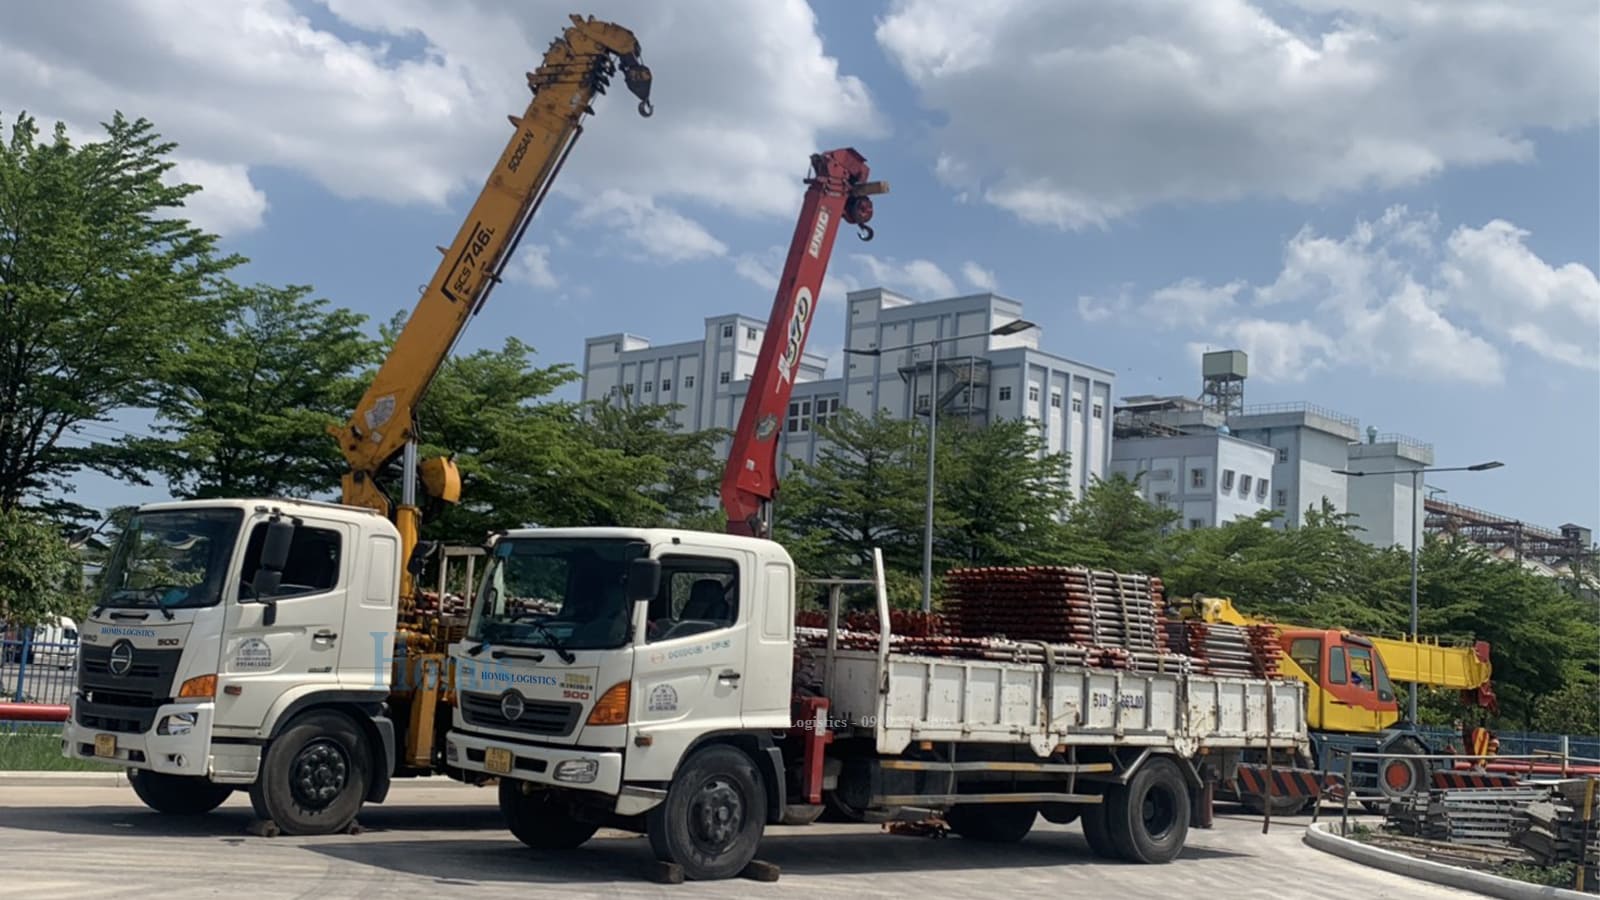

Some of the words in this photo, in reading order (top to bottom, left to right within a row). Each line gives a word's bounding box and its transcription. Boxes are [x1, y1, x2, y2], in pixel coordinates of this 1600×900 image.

[508, 128, 535, 174] SOOSAN
[100, 625, 122, 635] HOMIS
[123, 628, 156, 638] LOGISTICS
[157, 638, 180, 646] 500
[481, 671, 510, 682] HOMIS
[511, 674, 557, 686] LOGISTICS
[563, 690, 589, 700] 500
